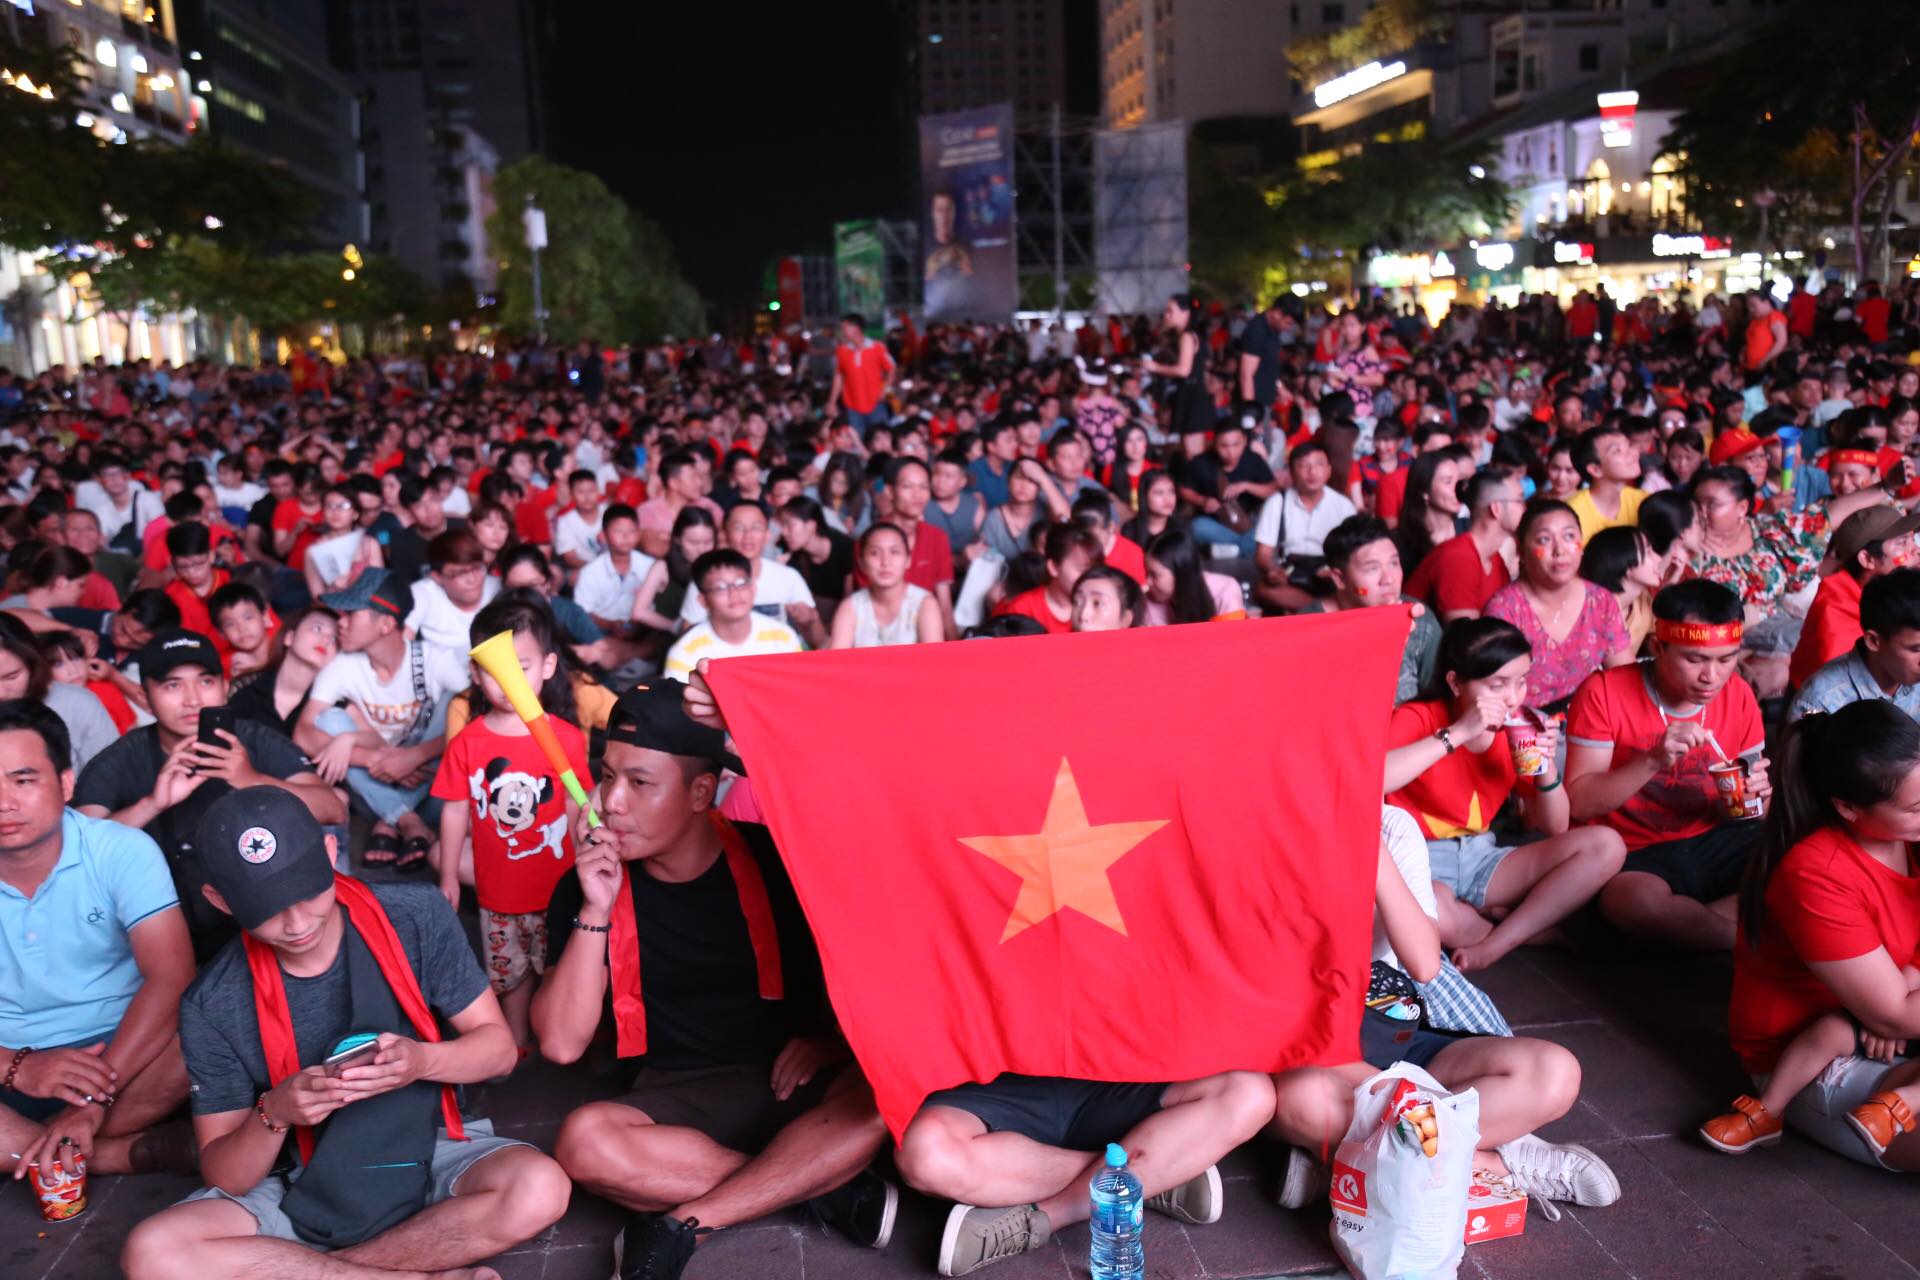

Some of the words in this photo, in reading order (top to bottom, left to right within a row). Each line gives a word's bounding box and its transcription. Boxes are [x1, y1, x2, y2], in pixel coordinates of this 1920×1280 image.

[1689, 629, 1711, 640] NAM
[1343, 1178, 1359, 1200] K
[1341, 1218, 1364, 1232] easy
